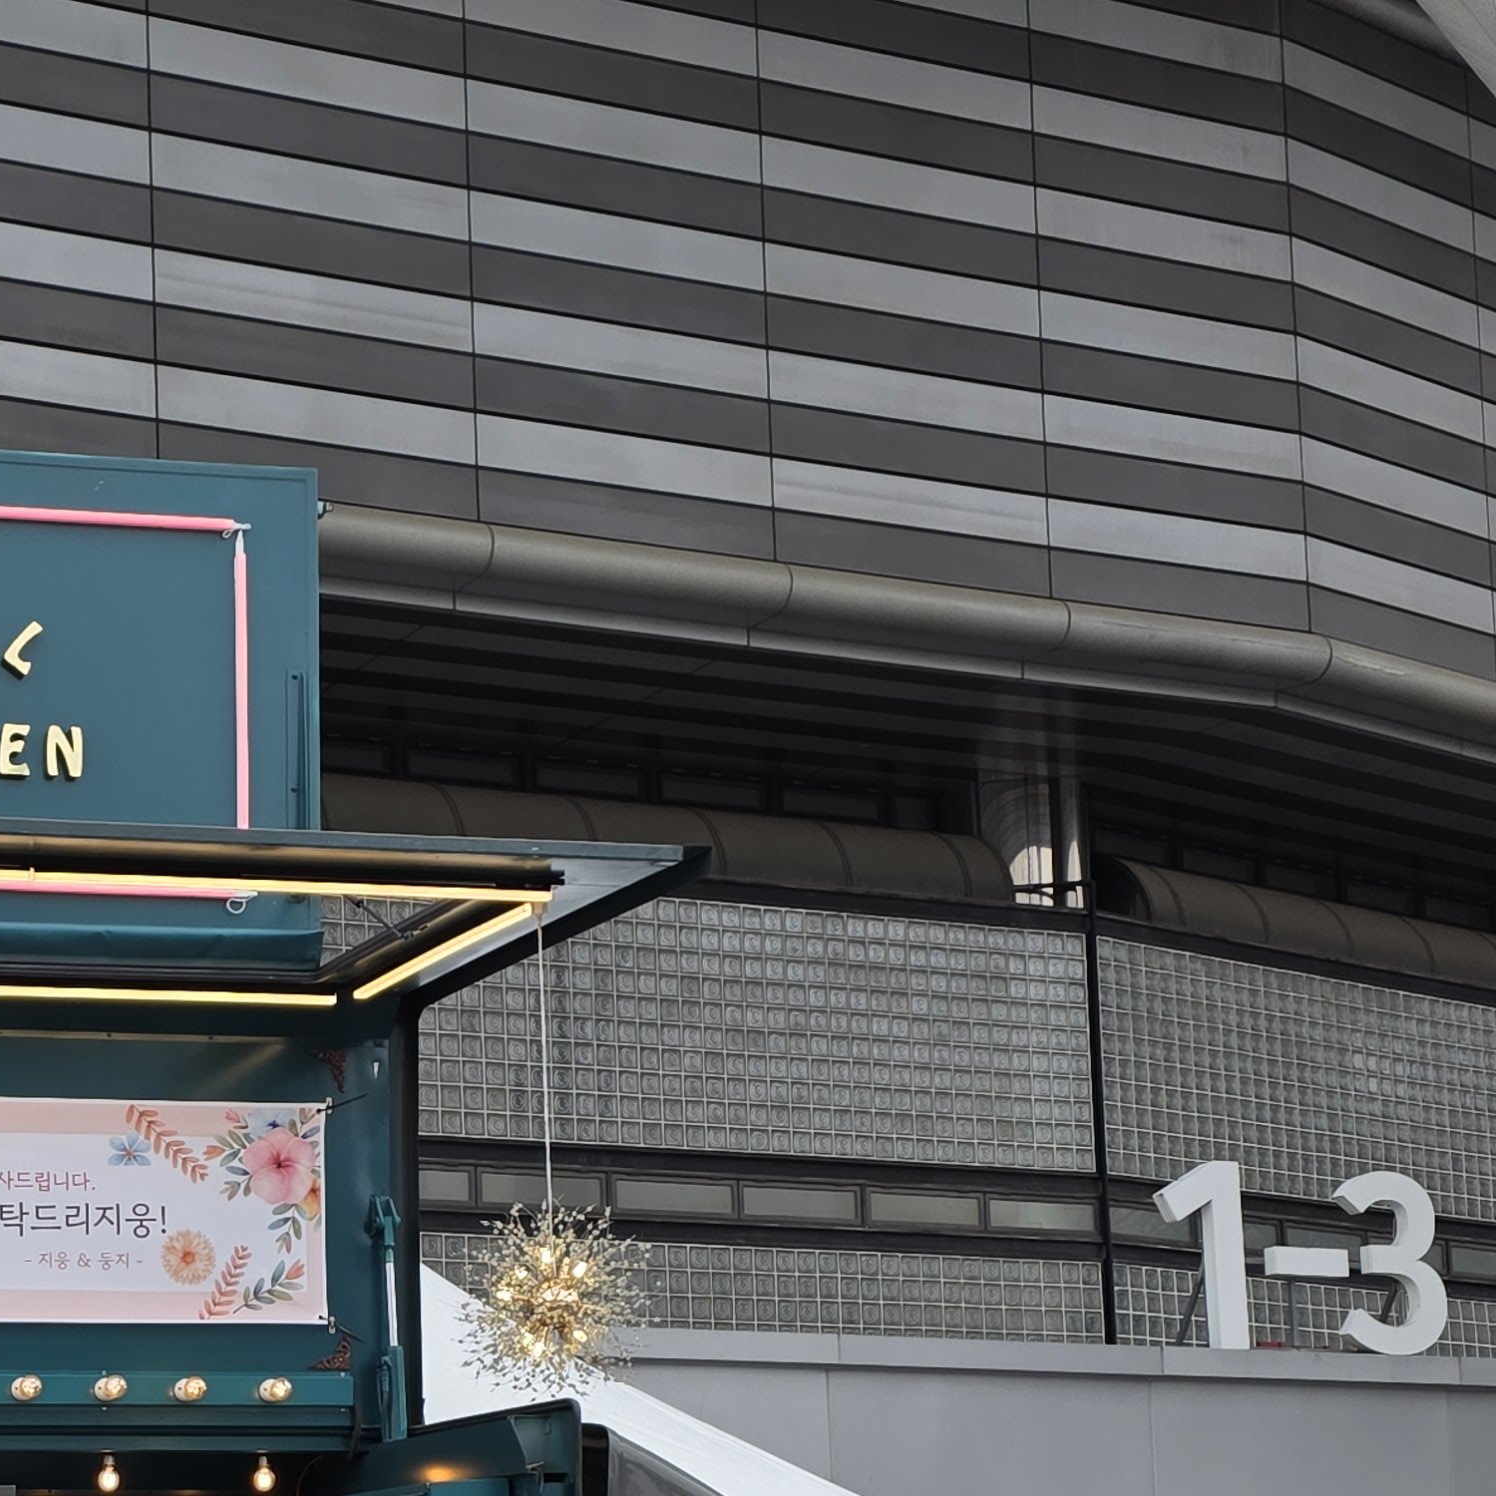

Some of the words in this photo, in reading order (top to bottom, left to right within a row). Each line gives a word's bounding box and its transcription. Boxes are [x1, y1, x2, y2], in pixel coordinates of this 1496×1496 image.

[37, 1251, 71, 1271] 지웅
[76, 1252, 92, 1269] &
[97, 1251, 131, 1272] 둥지
[1152, 1160, 1448, 1356] 1-3
